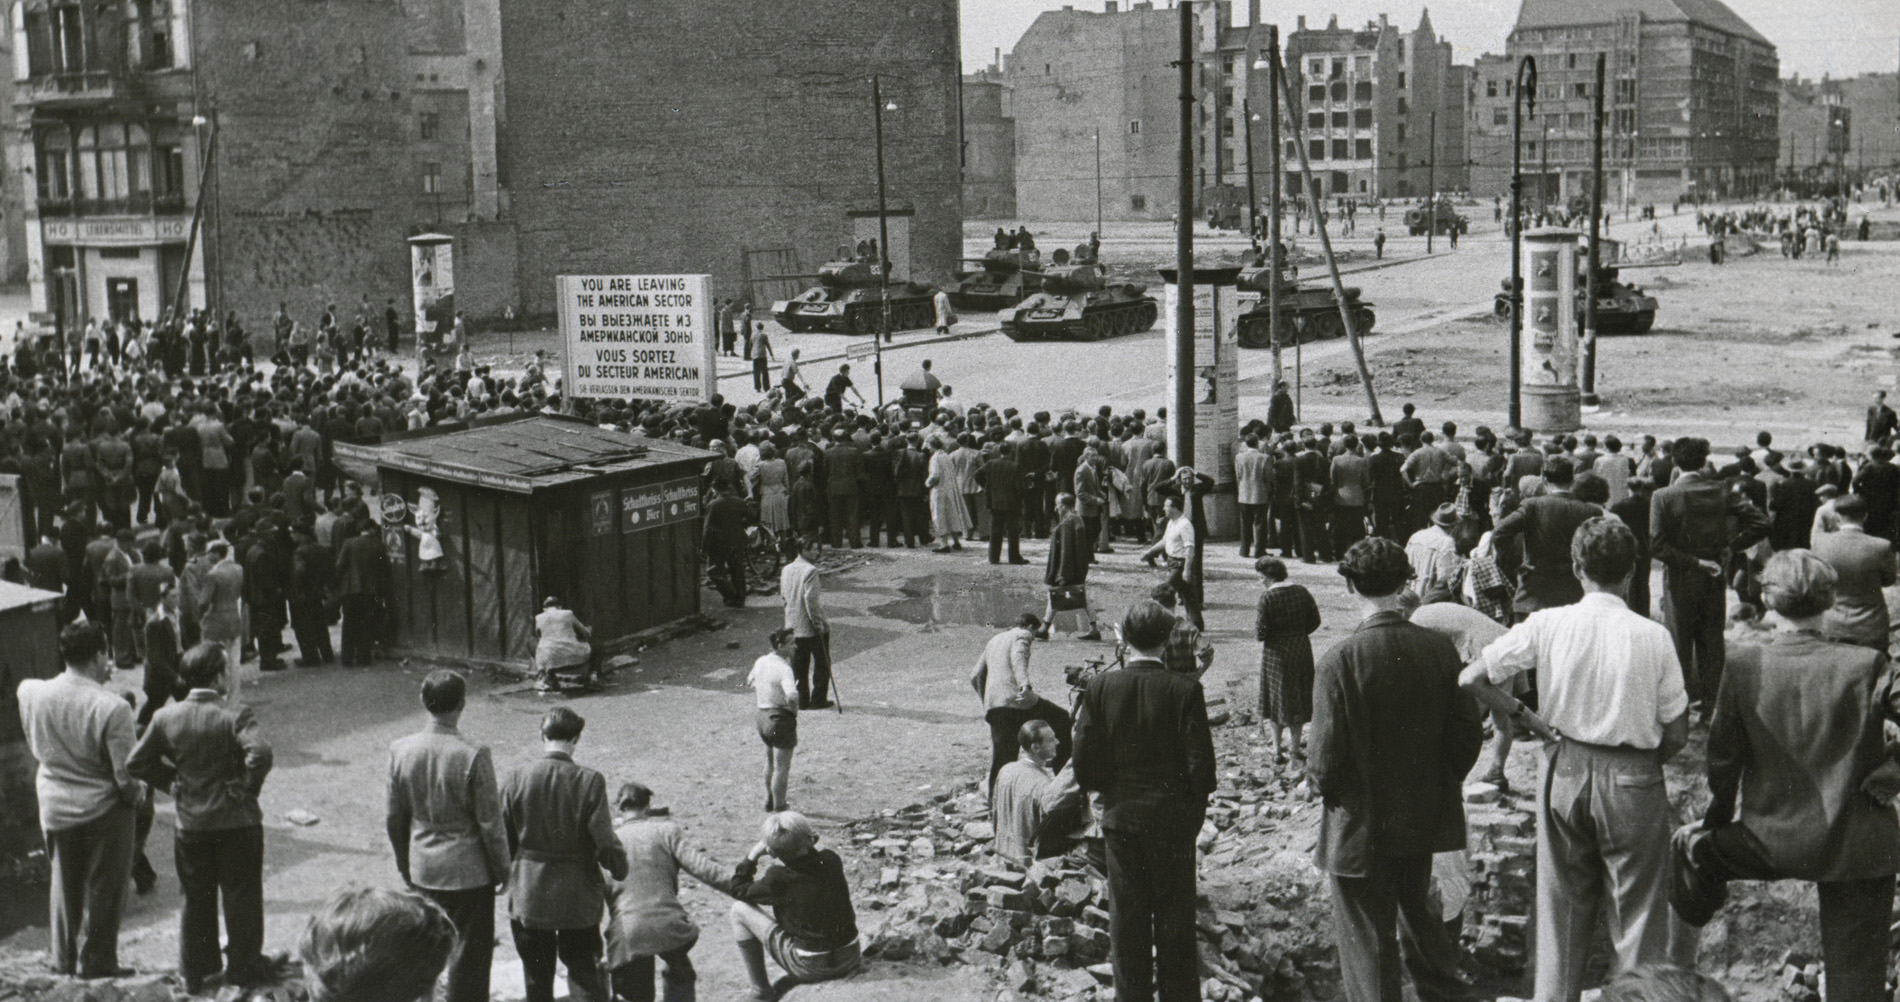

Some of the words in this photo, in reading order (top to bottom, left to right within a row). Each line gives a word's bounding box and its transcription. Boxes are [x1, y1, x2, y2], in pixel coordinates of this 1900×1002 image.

[48, 223, 68, 236] HO
[163, 223, 183, 235] HO
[581, 278, 603, 291] YOU
[609, 278, 631, 291] ARE
[638, 278, 685, 291] LEAVING
[577, 294, 594, 307] THE
[598, 294, 649, 307] AMERICAN
[654, 294, 692, 307] SECTOR
[579, 314, 596, 327] ВЫ
[602, 314, 670, 327] ВЫЕЗЖАЕТЕ
[676, 314, 691, 327] ИЗ
[580, 328, 659, 343] АМЕРИКАНСКОЙ
[664, 331, 693, 343] ЗОНЫ
[596, 349, 626, 363] VOUS
[632, 350, 676, 363] SORTEZ
[578, 365, 591, 378] DU
[596, 365, 639, 379] SECTEUR
[643, 366, 699, 380] AMERICAIN
[579, 384, 587, 394] SIE
[589, 384, 618, 394] VERLASSEN
[620, 385, 631, 394] DEN
[632, 385, 677, 396] AMERIKANISCHEN
[679, 386, 699, 397] SEKTOR
